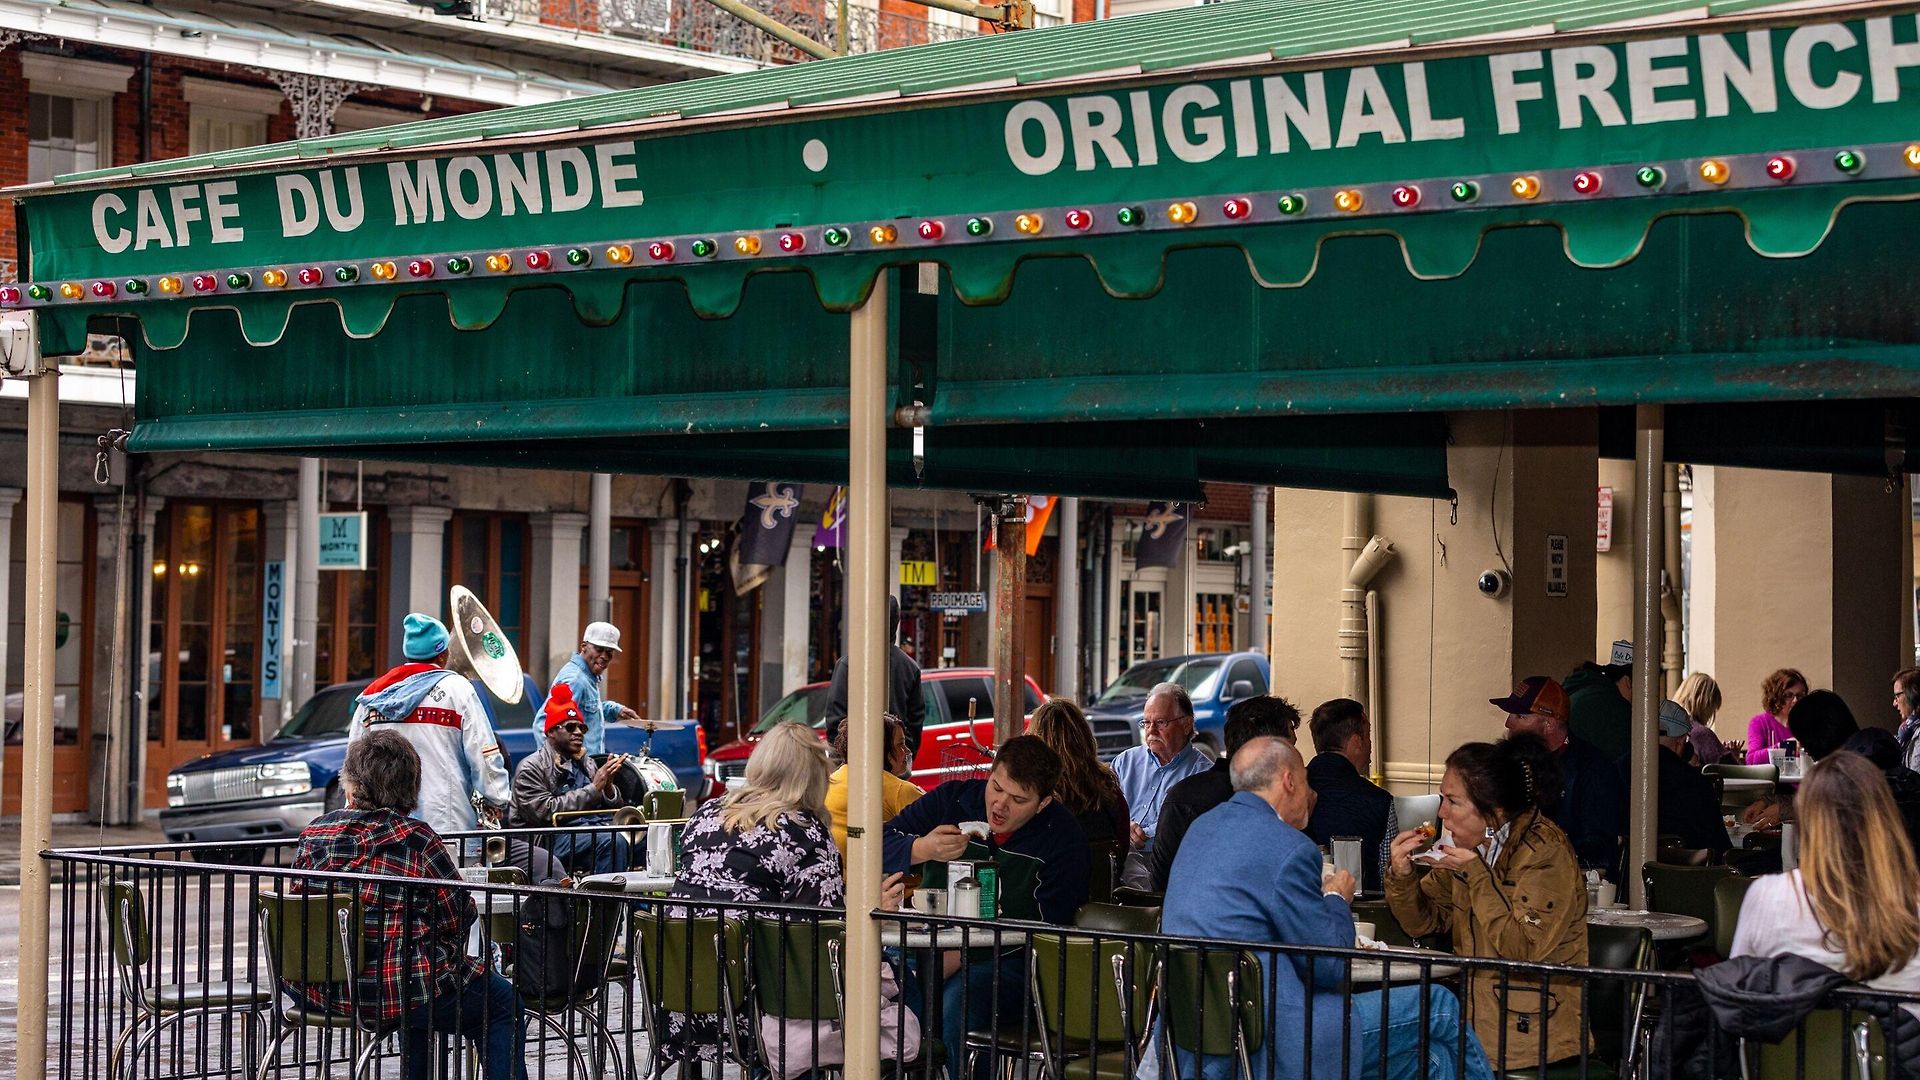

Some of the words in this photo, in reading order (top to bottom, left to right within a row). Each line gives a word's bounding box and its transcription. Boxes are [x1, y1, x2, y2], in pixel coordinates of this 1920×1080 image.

[1004, 61, 1465, 176] ORIGINAL
[1489, 14, 1920, 135] FRENCH
[91, 180, 244, 254] CAFE
[275, 166, 365, 238] DU
[386, 141, 644, 226] MONDE
[332, 518, 347, 538] M
[901, 562, 925, 583] TM
[265, 563, 281, 680] MONTY'S
